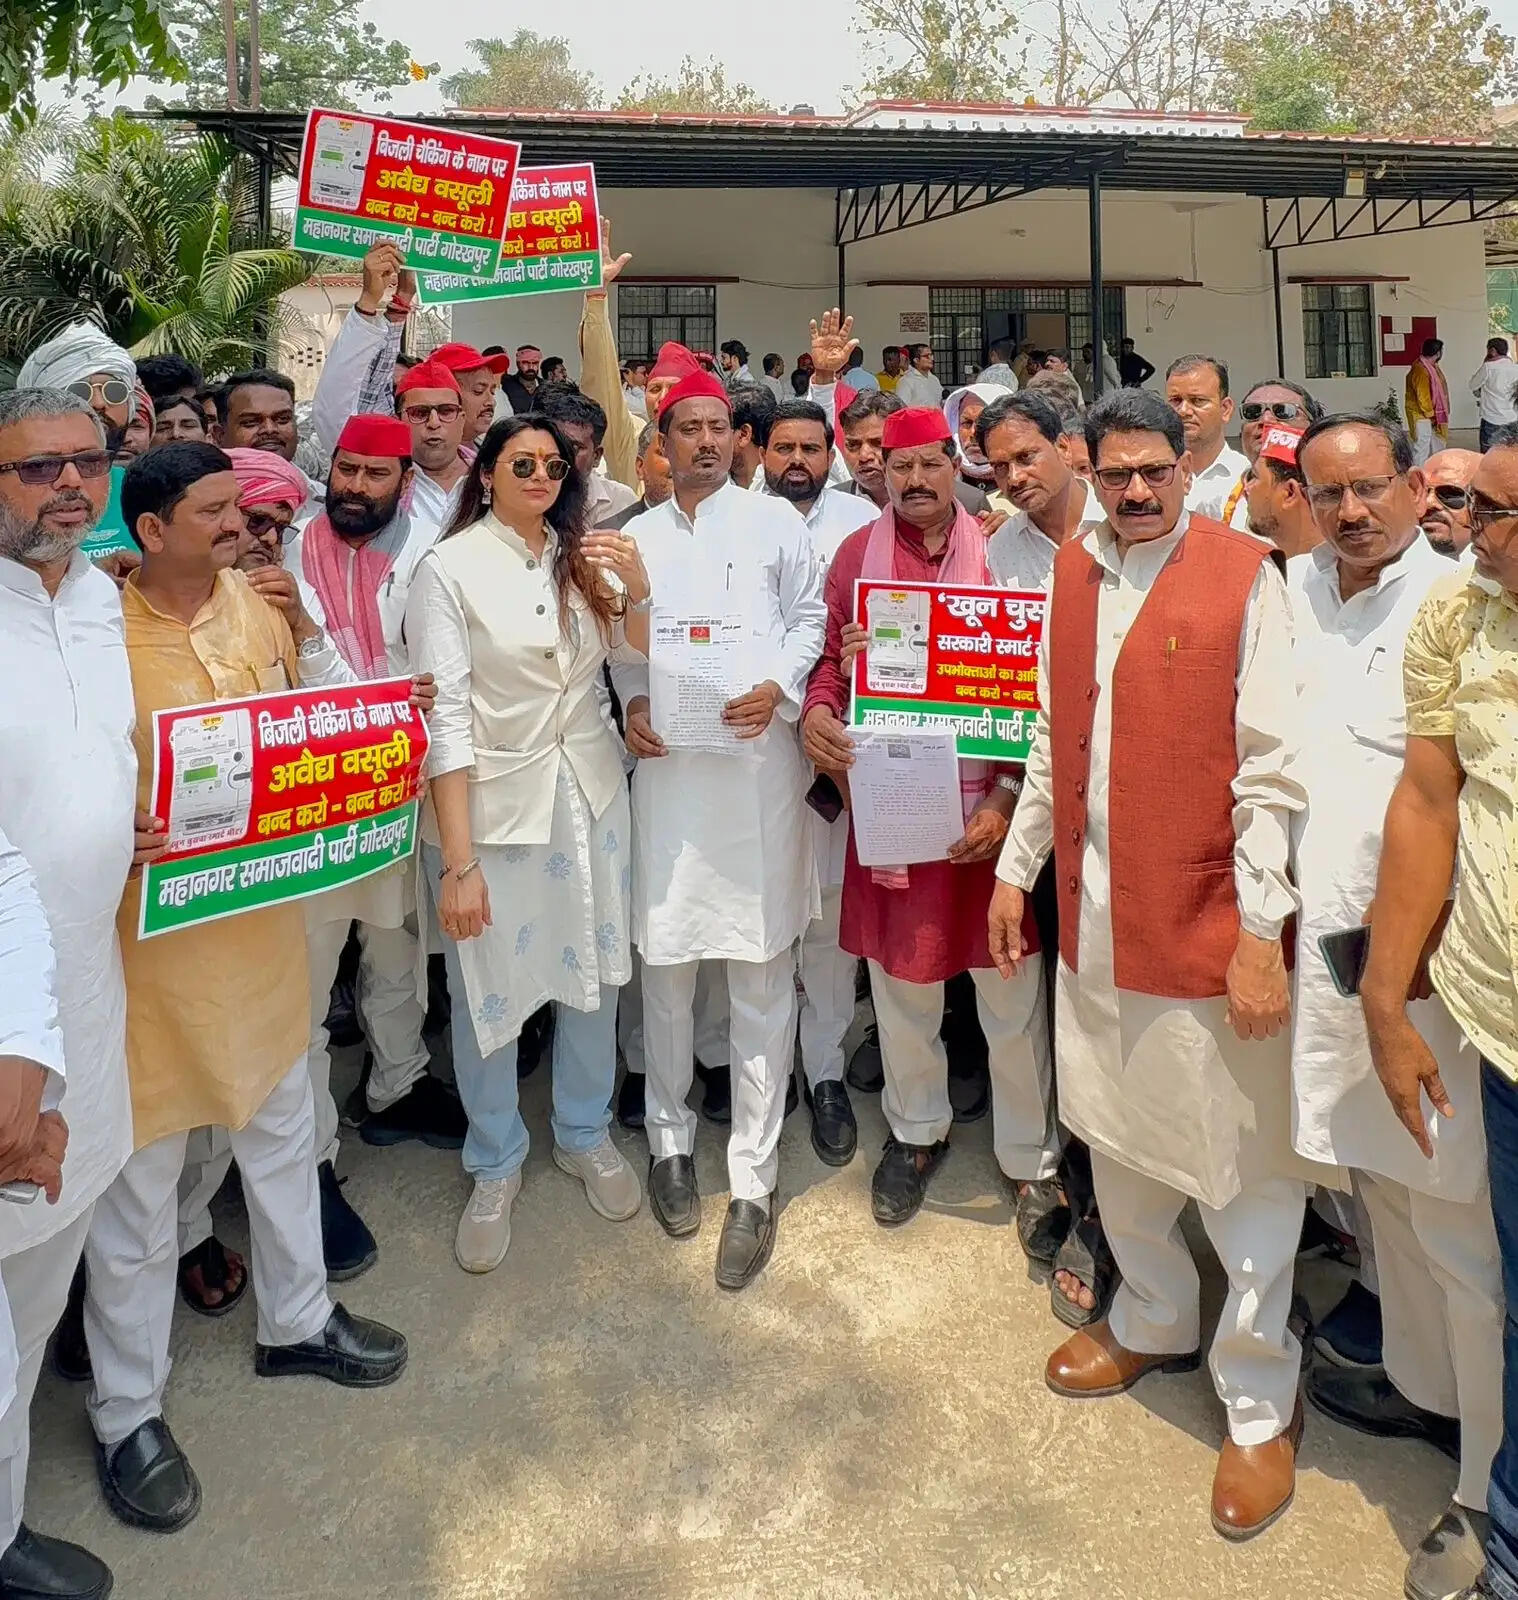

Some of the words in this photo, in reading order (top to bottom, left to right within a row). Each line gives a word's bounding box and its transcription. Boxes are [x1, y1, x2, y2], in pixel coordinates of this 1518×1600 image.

[376, 129, 415, 161] बिजली
[416, 137, 452, 167] चेकिंग
[452, 145, 467, 170] के
[466, 153, 492, 174] नाम
[492, 158, 509, 178] पर
[376, 165, 431, 194] अवैद्य
[434, 178, 495, 212] वसूली
[538, 176, 551, 199] के
[551, 181, 573, 198] नाम
[573, 180, 587, 197] पर
[365, 199, 392, 217] बन्द
[393, 200, 419, 222] करो
[432, 210, 460, 228] बन्द
[460, 212, 486, 233] करो
[487, 216, 495, 234] !
[530, 200, 583, 233] वसूली
[303, 217, 352, 243] महानगर
[414, 232, 440, 258] पार्टी
[441, 236, 492, 273] गोरखपुर
[503, 234, 524, 254] करो
[536, 236, 559, 252] बन्द
[560, 230, 582, 249] करो
[584, 231, 590, 248] !
[527, 256, 549, 280] पार्टी
[549, 257, 594, 284] गोरखपुर
[937, 631, 993, 654] सरकारी
[995, 634, 1033, 657] स्मार्ट
[998, 668, 1014, 680] का
[956, 685, 977, 697] बन्द
[980, 683, 1000, 700] करो
[1012, 690, 1036, 702] बन्द
[258, 705, 306, 749] बिजली
[307, 701, 351, 738] चेकिंग
[351, 698, 367, 730] के
[367, 701, 395, 727] नाम
[393, 700, 413, 722] पर
[995, 711, 1024, 742] पार्टी
[268, 747, 337, 792] अवैद्य
[341, 729, 411, 784] वसूली
[257, 808, 293, 836] बन्द
[296, 792, 328, 827] करो
[331, 803, 342, 812] -
[345, 788, 377, 815] बन्द
[378, 774, 406, 806] करो
[158, 862, 237, 907] महानगर
[239, 832, 326, 888] समाजवादी
[328, 823, 360, 865] पार्टी
[359, 814, 411, 856] गोरखपुर
